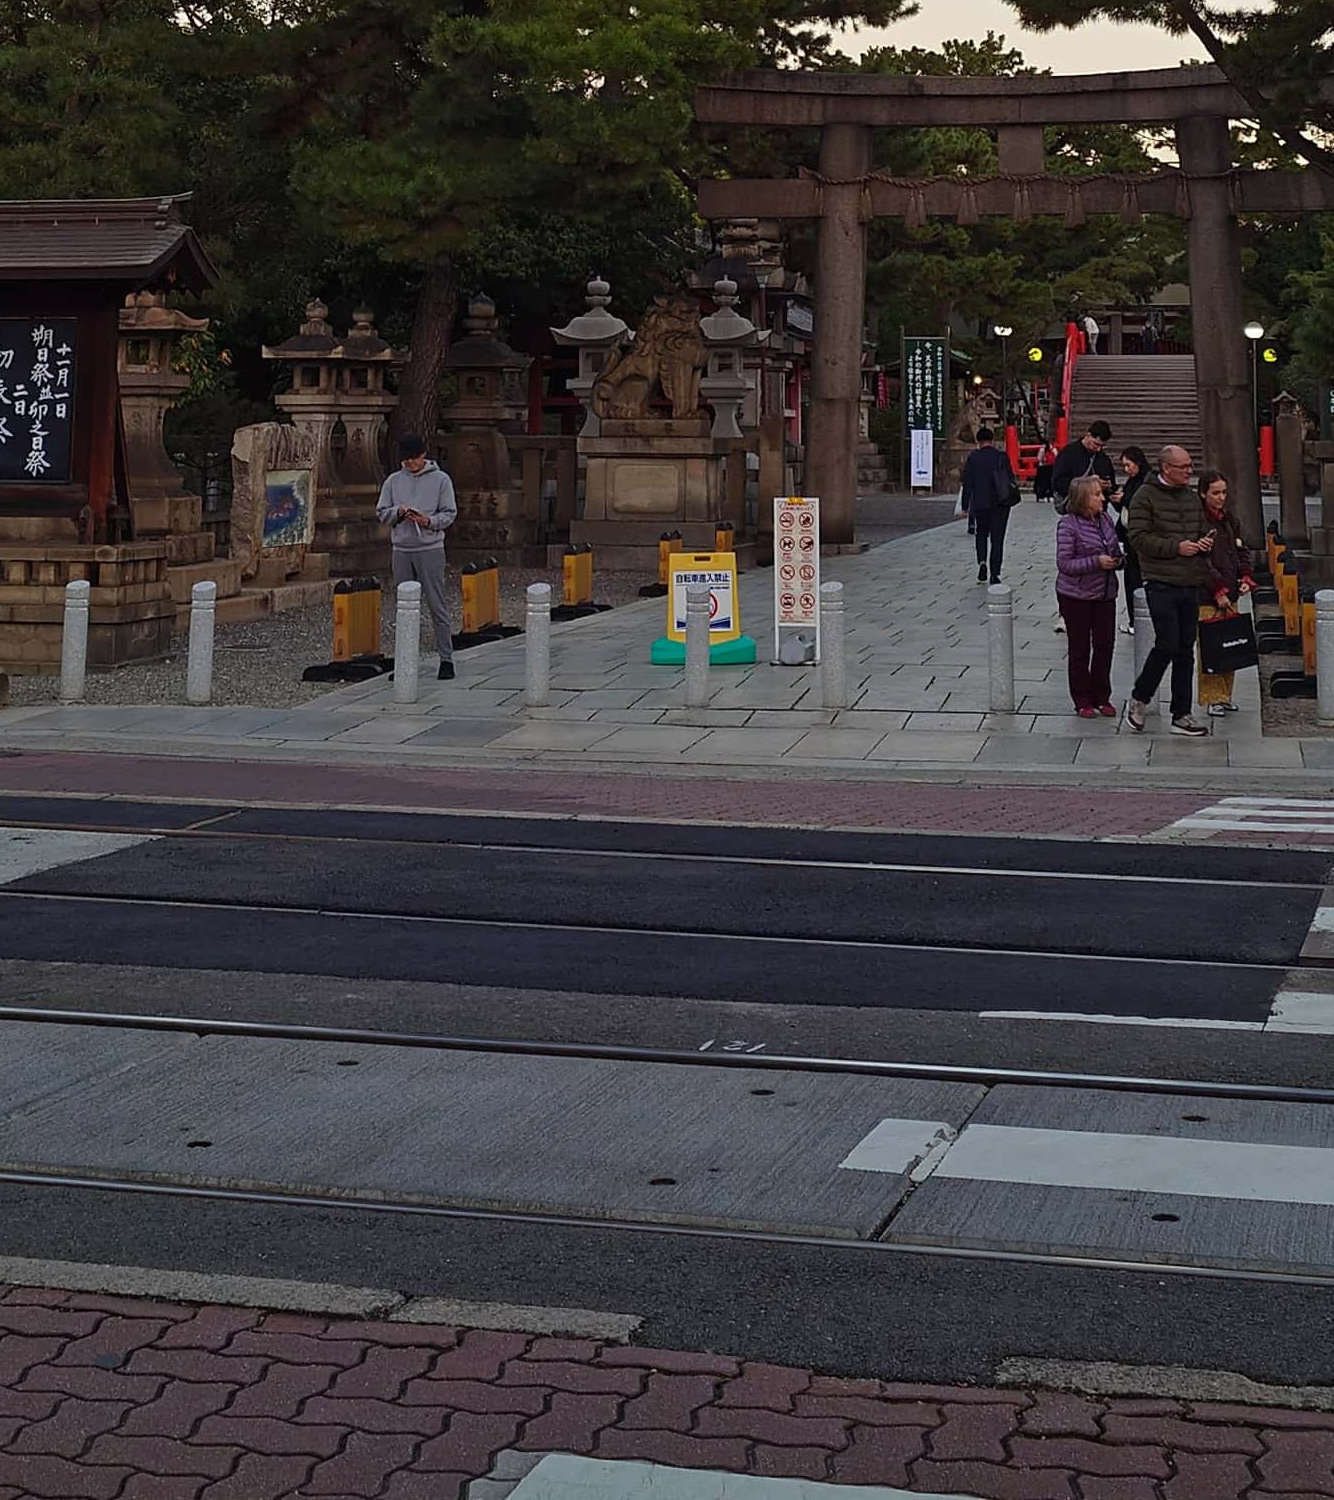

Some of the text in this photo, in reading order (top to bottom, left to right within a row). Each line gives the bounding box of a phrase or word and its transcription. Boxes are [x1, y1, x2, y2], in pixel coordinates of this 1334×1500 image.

[12, 383, 29, 417] 二日
[54, 342, 73, 420] 十一月一日
